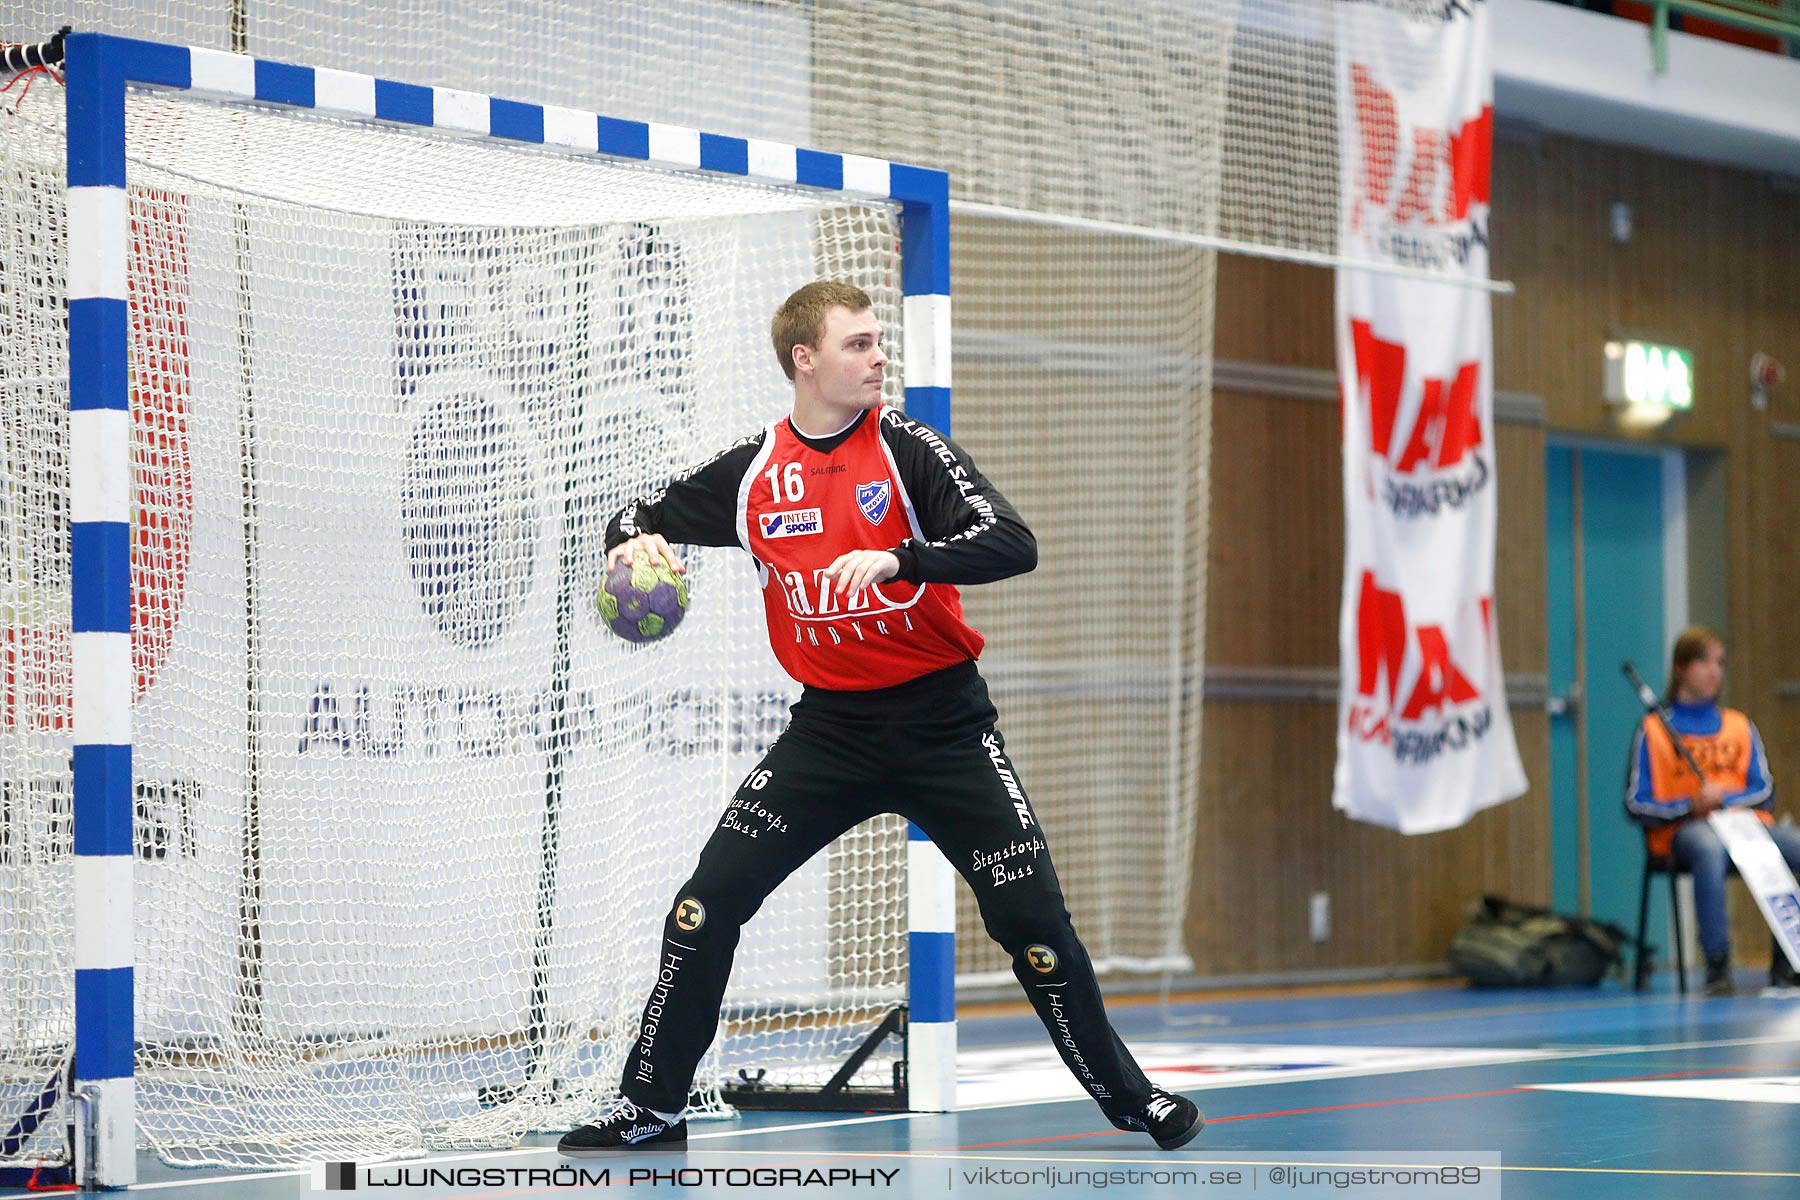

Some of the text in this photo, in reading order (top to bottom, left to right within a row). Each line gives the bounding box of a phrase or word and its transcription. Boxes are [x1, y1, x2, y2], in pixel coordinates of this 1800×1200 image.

[765, 462, 805, 504] 16
[783, 511, 817, 524] INTER
[785, 521, 818, 534] SPORT
[743, 768, 773, 791] 16
[721, 809, 759, 839] Buss
[972, 836, 1045, 872] Stenstorps
[991, 863, 1034, 887] Buss
[636, 952, 683, 1084] Holmgrens Bil
[1048, 992, 1112, 1099] Holmgrens Bil
[620, 1123, 666, 1141] Salming
